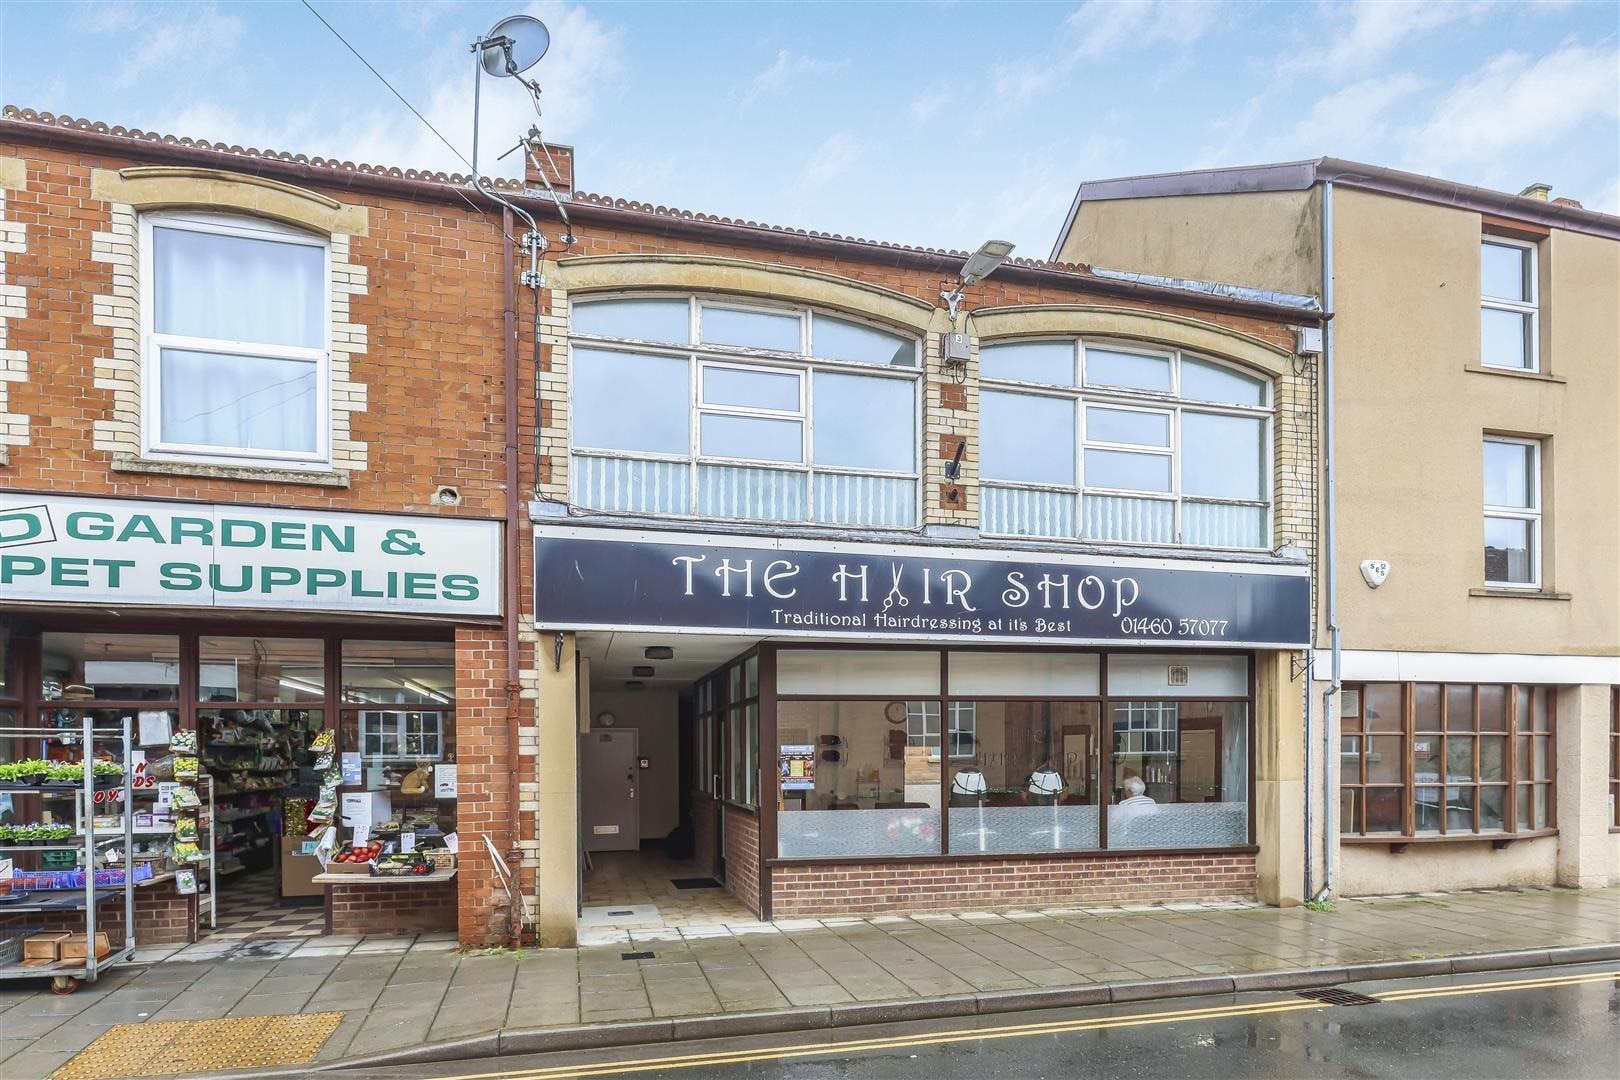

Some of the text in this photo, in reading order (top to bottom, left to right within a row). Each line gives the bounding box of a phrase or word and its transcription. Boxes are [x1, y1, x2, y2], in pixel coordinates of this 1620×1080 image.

[66, 511, 355, 553] GARDEN
[380, 528, 426, 556] &
[1, 555, 480, 601] PET SUPPLIES
[672, 555, 800, 599] THE
[1001, 571, 1140, 618] SHOP
[771, 609, 1071, 634] Traditional Hairdressing at it's Best
[1121, 616, 1229, 636] 01460 57077
